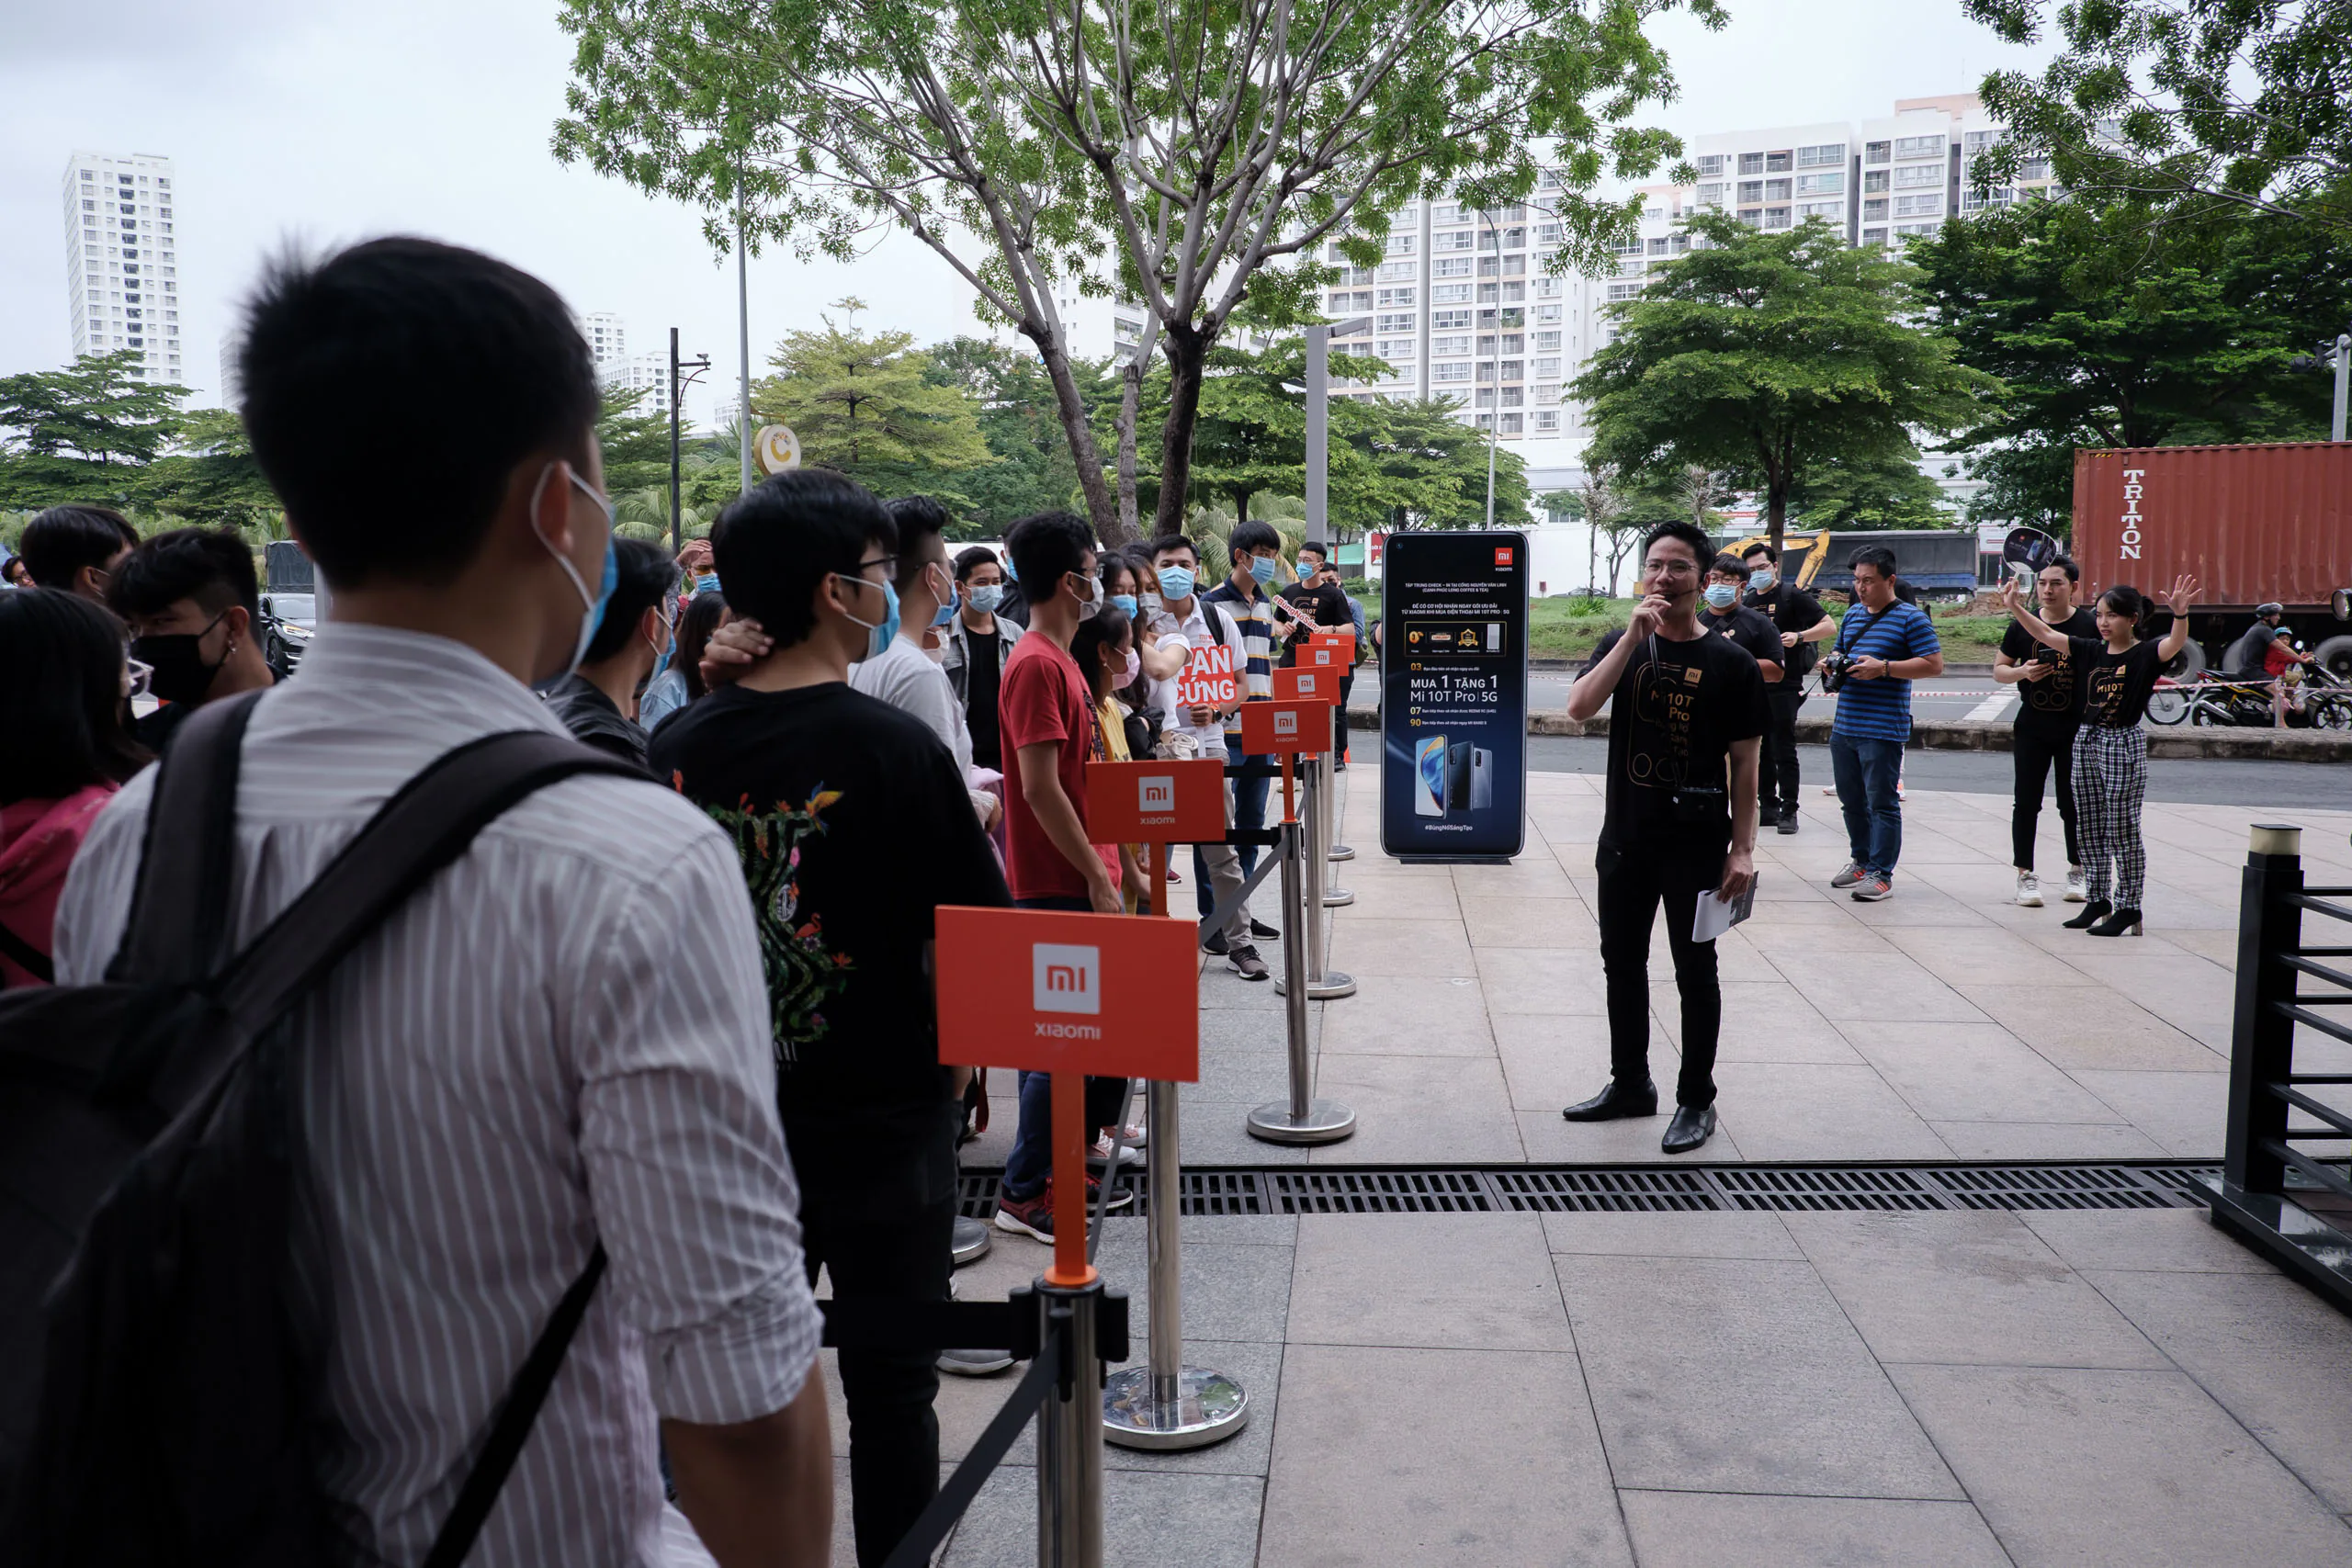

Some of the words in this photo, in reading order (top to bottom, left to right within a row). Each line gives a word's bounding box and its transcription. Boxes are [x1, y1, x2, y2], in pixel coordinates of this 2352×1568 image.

[2120, 469, 2145, 559] TRITON
[1410, 662, 1422, 671] 03
[1410, 679, 1437, 688] MUA
[1441, 674, 1448, 688] 1
[1453, 677, 1486, 690] TẶNG
[1490, 674, 1498, 688] 1
[1410, 691, 1425, 702] Mi
[1428, 691, 1452, 702] 10T
[1454, 691, 1476, 702] Pro
[1481, 691, 1498, 702] 5G
[1410, 706, 1421, 715] 07
[1668, 706, 1690, 721] Pro
[1410, 718, 1421, 727] 90
[1139, 817, 1176, 826] xiaomi
[1034, 1021, 1102, 1041] xiaomi
